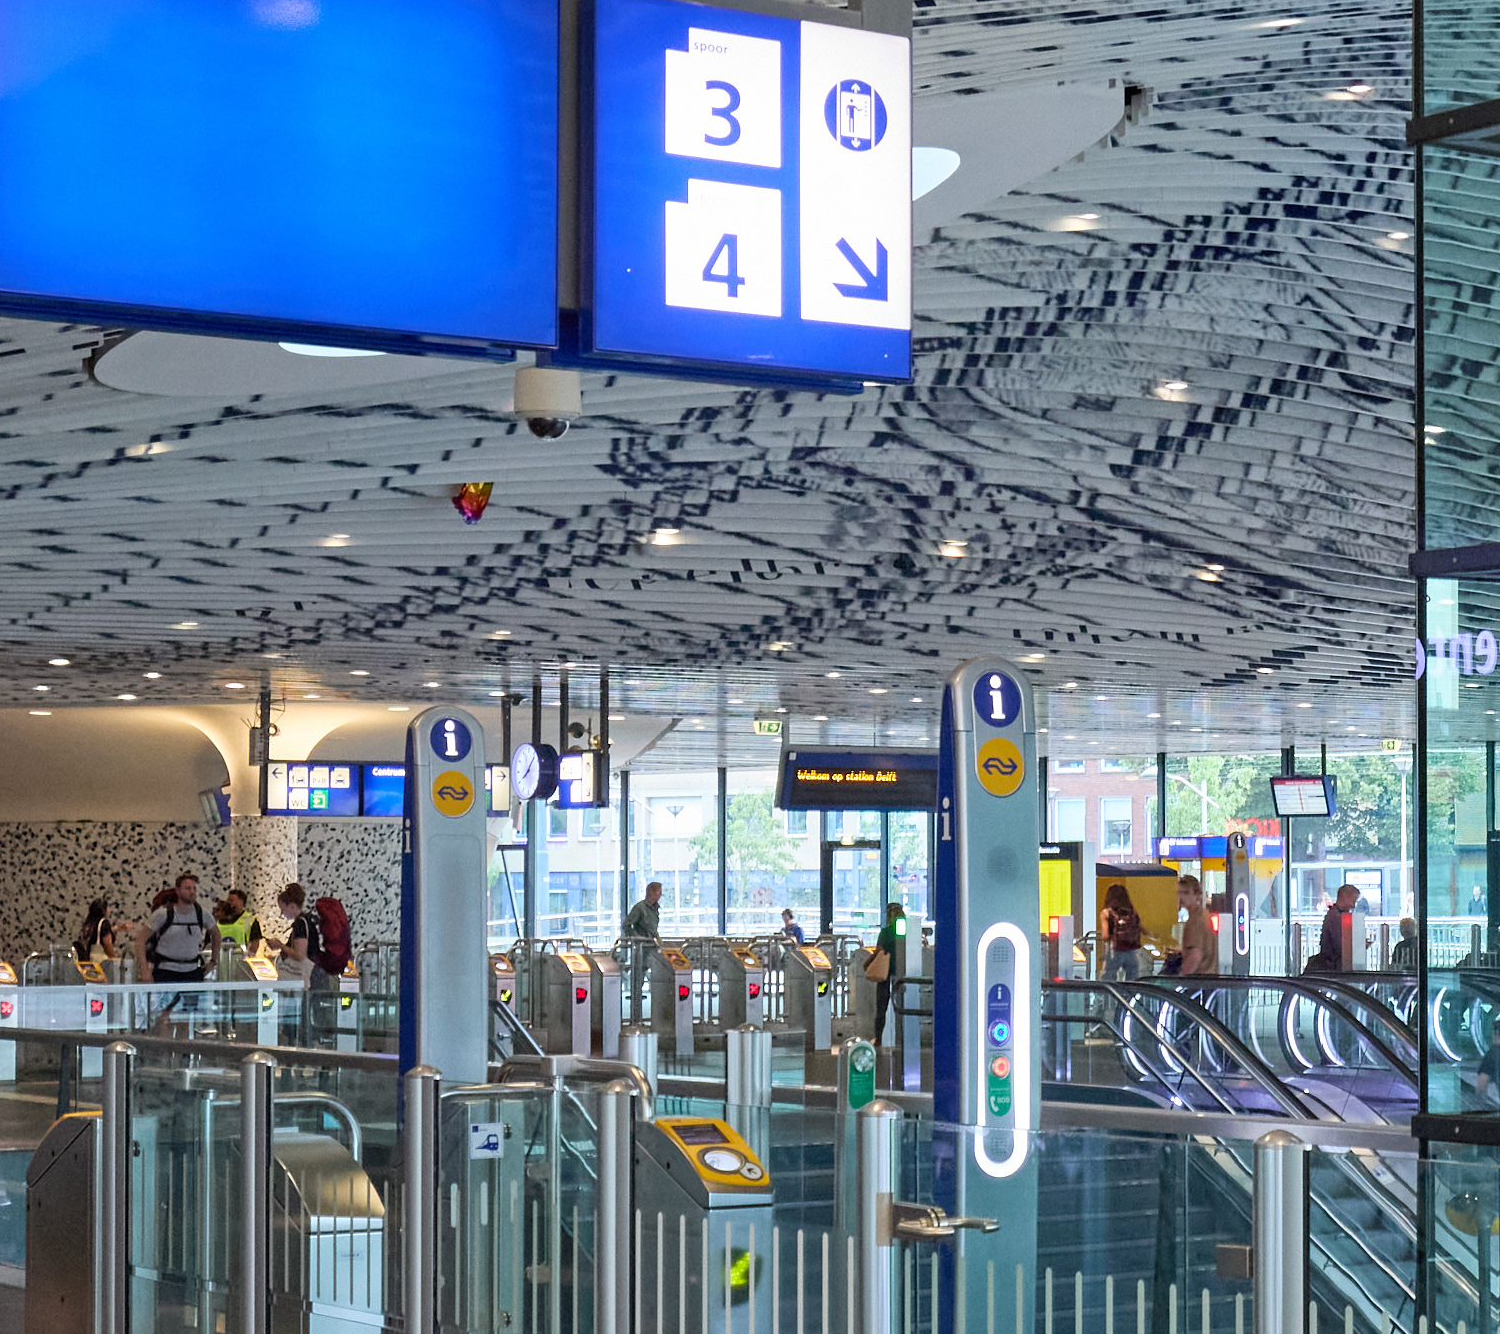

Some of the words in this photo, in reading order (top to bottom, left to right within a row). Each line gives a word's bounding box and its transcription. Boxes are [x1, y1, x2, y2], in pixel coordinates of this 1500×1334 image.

[693, 40, 729, 55] spoor
[703, 79, 741, 147] 3
[701, 232, 746, 299] 4
[797, 769, 830, 781] Welkom
[832, 773, 844, 783] op
[845, 770, 875, 782] station
[876, 771, 897, 782] Delft
[291, 799, 306, 807] WC
